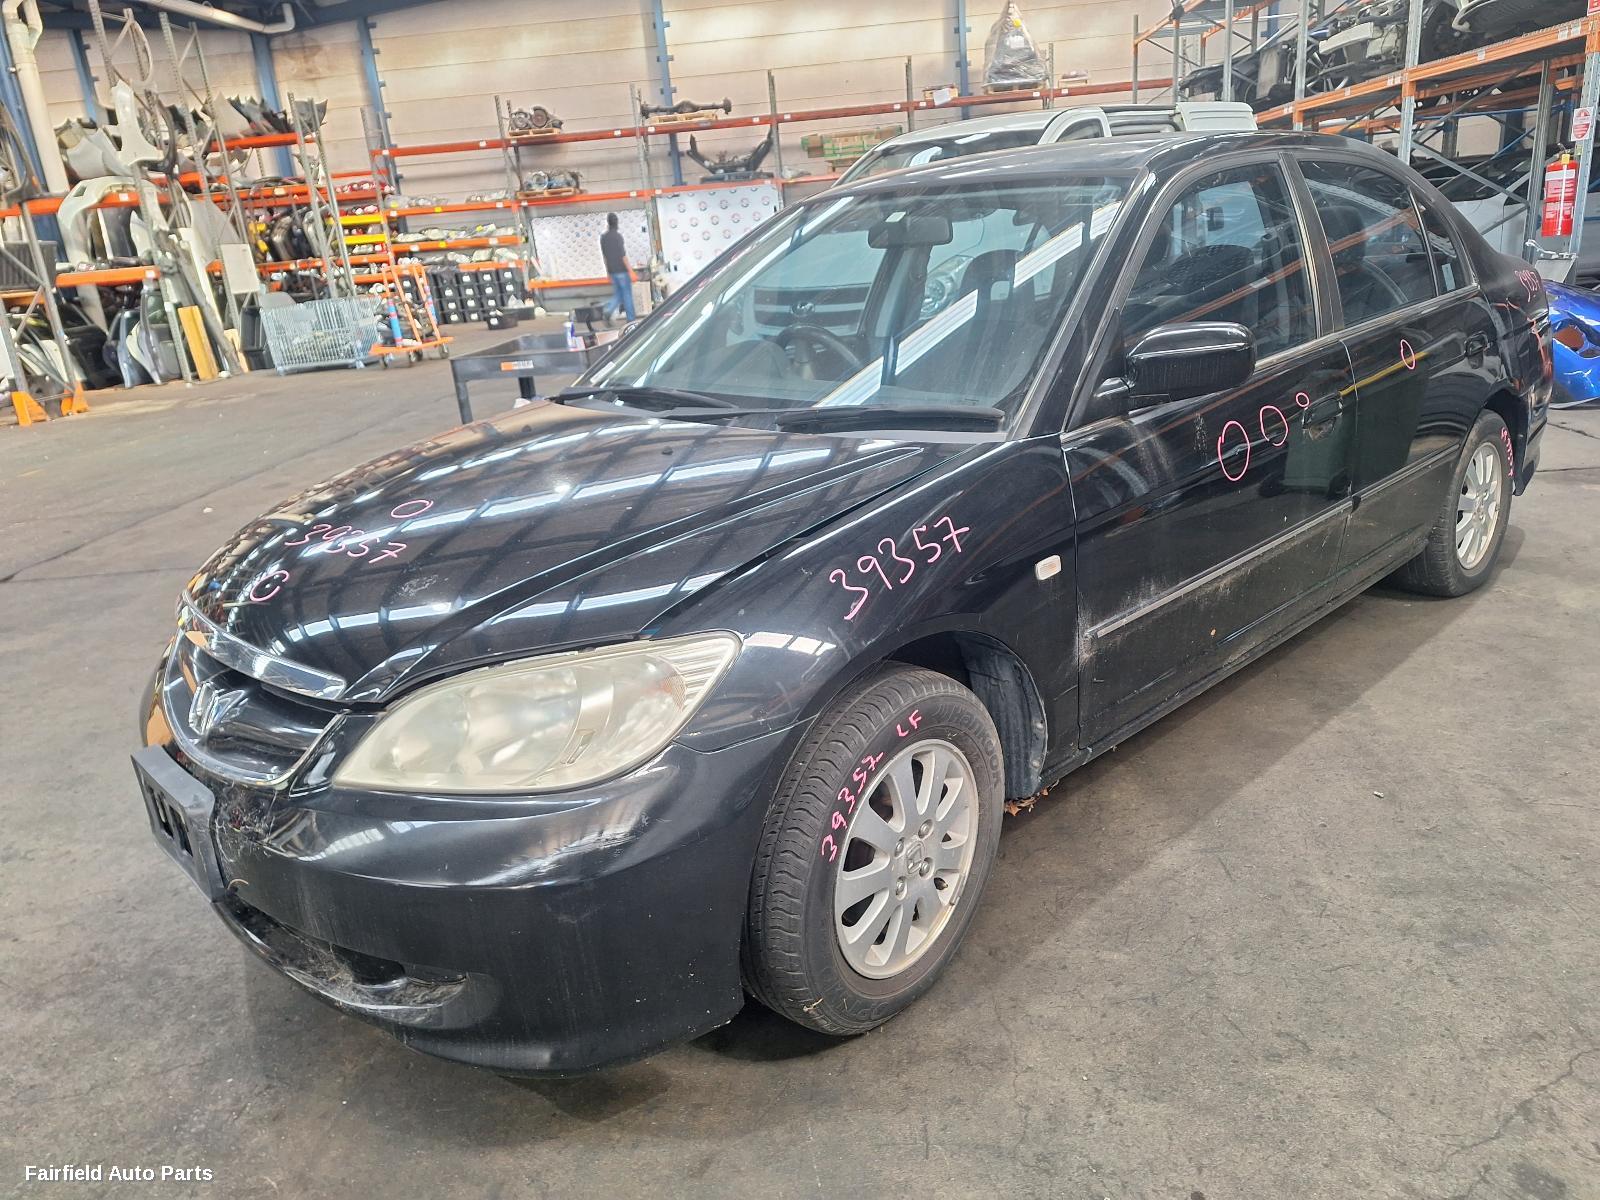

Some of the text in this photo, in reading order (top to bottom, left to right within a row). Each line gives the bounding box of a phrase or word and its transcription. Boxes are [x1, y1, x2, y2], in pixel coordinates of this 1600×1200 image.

[829, 516, 970, 621] 39357
[821, 709, 922, 862] 39357 LF
